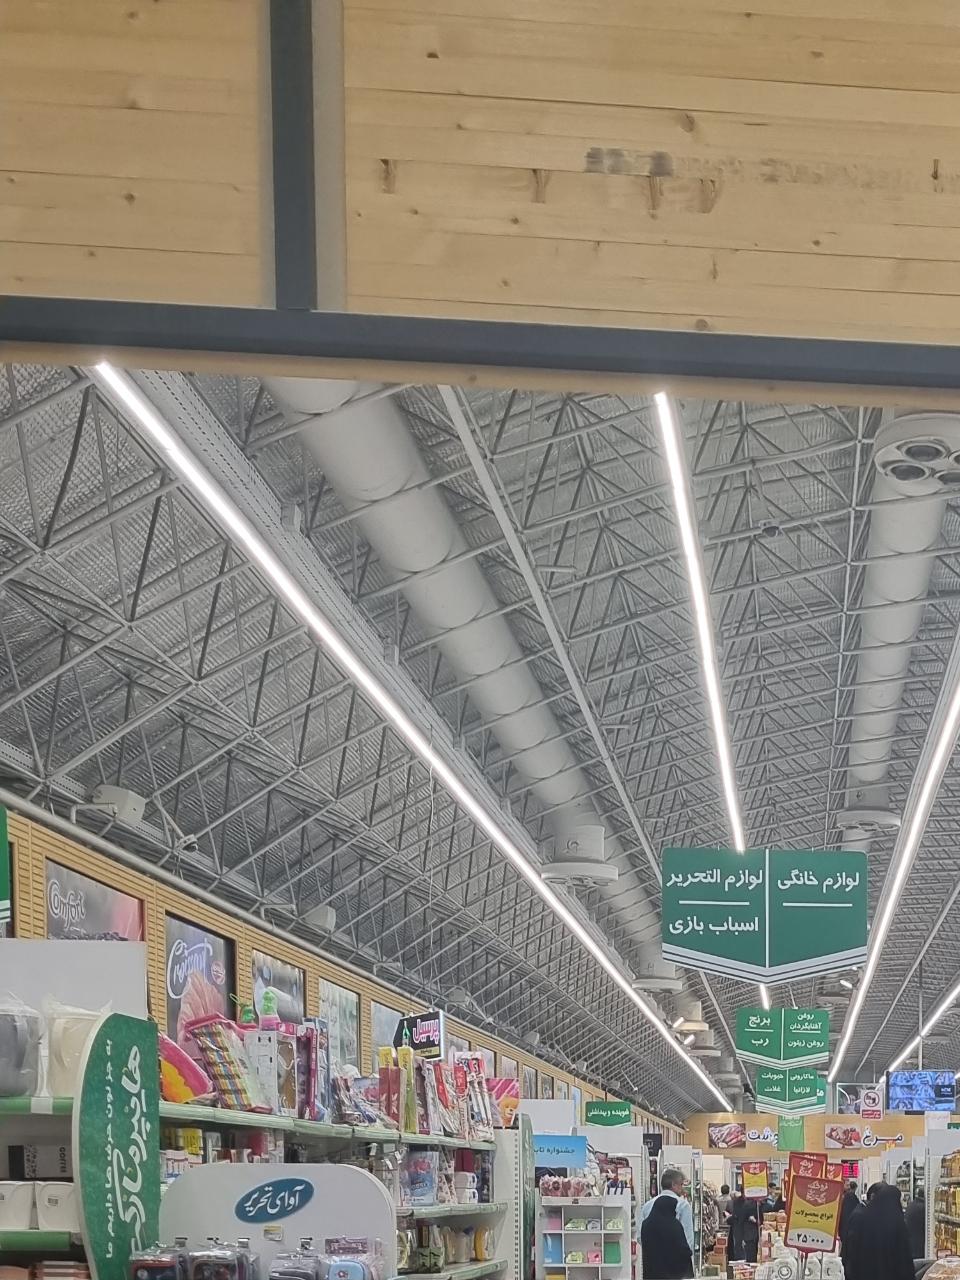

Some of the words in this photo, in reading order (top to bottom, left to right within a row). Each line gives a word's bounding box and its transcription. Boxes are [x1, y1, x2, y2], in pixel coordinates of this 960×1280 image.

[666, 868, 721, 887] التحریر
[724, 869, 763, 892] لوازم
[778, 869, 818, 889] خانگی
[823, 872, 860, 893] لوازم
[669, 916, 703, 934] بازی
[708, 916, 759, 935] اسباب
[748, 1015, 771, 1027] برنج
[751, 1037, 769, 1046] رب
[747, 1128, 778, 1146] وشت
[533, 1146, 544, 1154] تاب
[547, 1146, 575, 1155] جشنواره
[244, 1187, 273, 1216] تحریر
[268, 1184, 305, 1213] آوای
